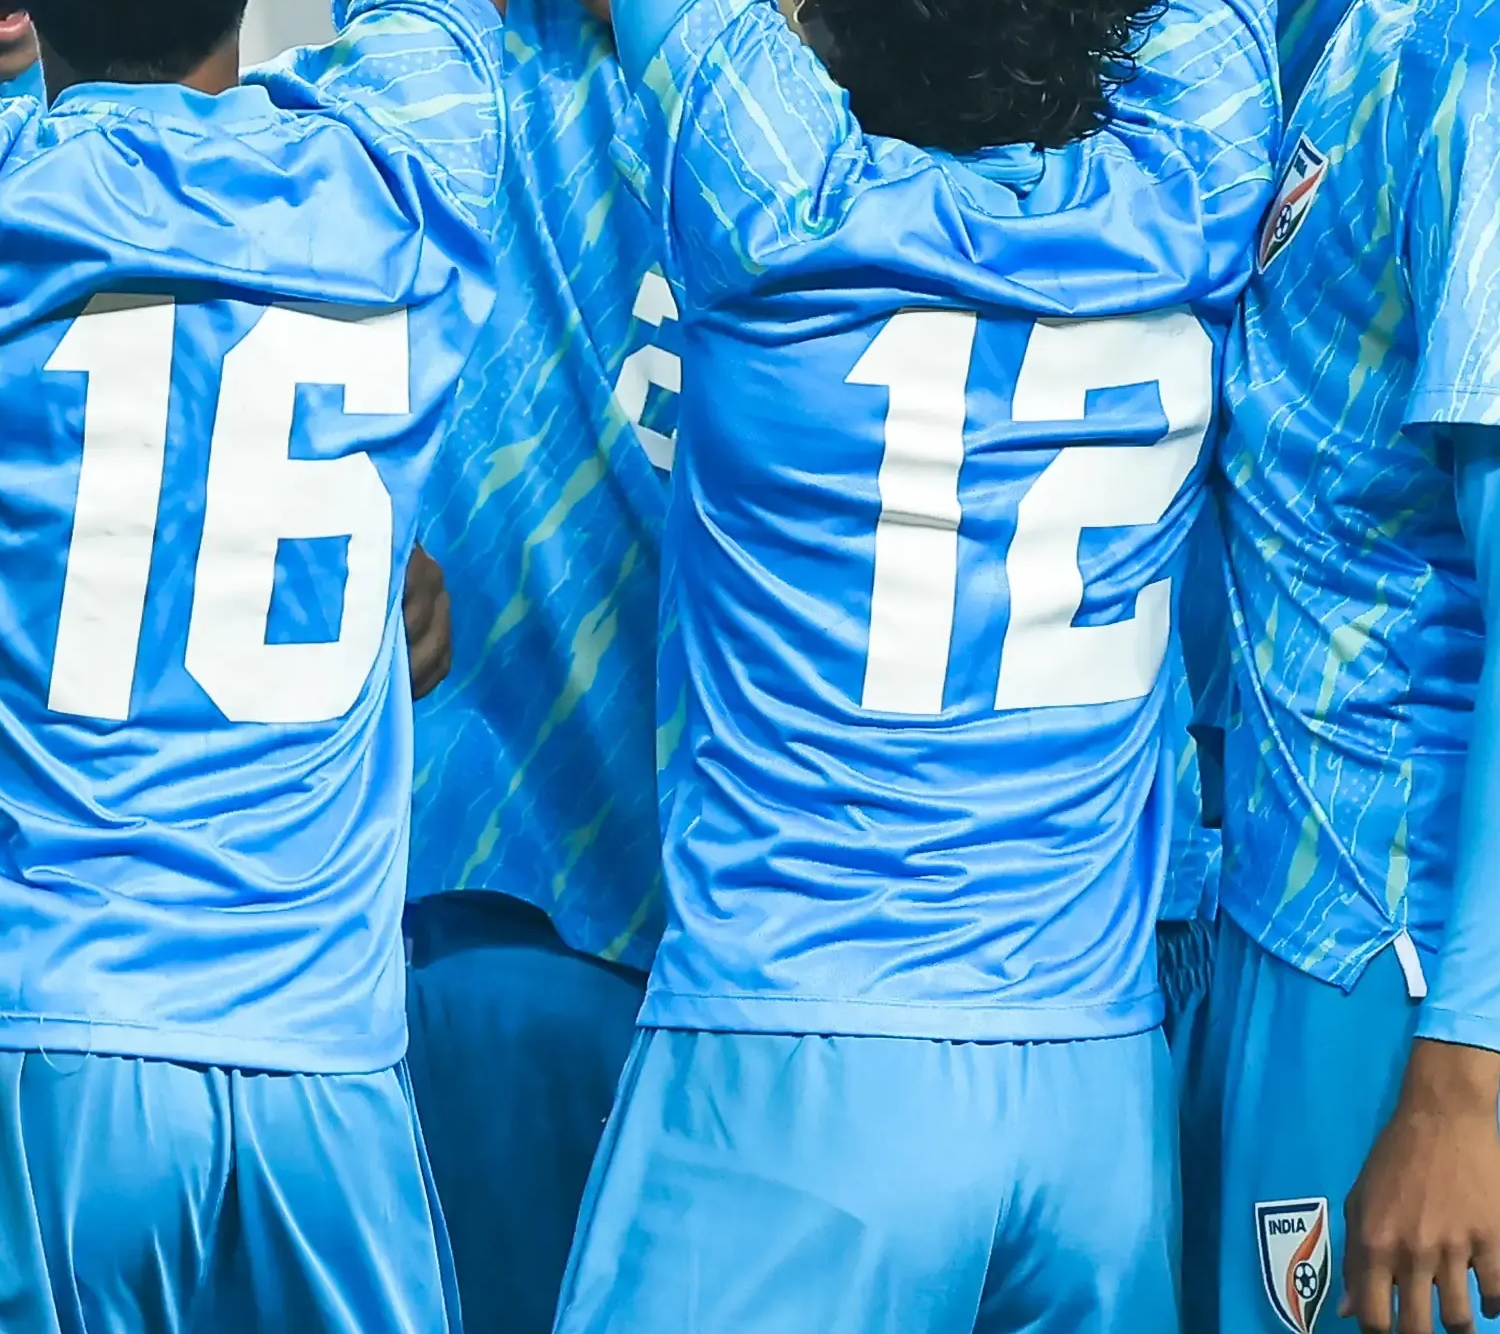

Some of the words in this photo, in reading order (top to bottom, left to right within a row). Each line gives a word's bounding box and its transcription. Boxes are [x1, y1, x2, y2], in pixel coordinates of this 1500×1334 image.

[43, 292, 410, 724] 16
[844, 303, 1214, 716] 12
[1268, 1217, 1307, 1236] INDIA
